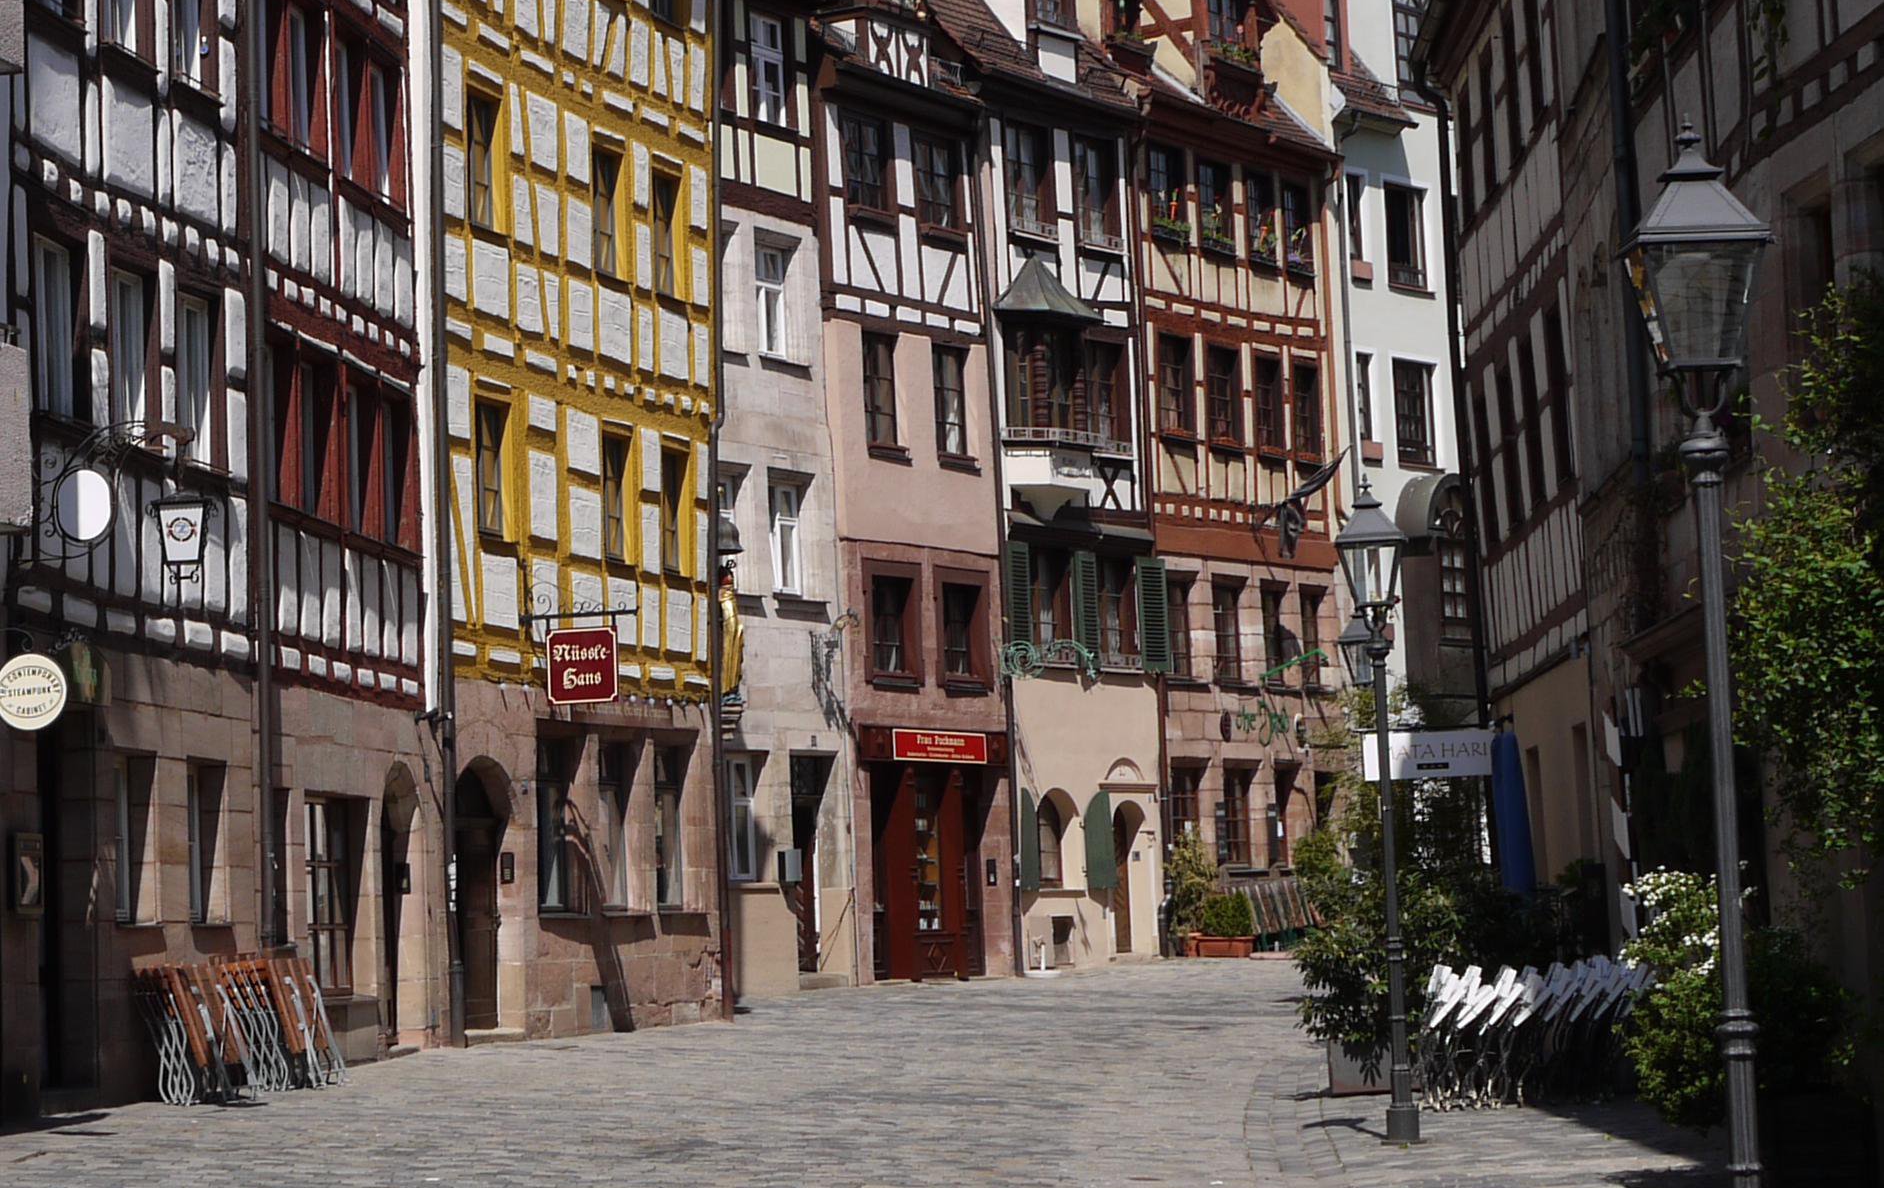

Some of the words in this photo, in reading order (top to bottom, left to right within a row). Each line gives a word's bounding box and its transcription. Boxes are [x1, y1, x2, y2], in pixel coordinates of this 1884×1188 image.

[552, 643, 611, 662] Nüssle-
[7, 667, 60, 693] CONTEMPORARY
[563, 667, 602, 690] Hans
[8, 685, 52, 697] STEAMPUNK
[16, 701, 47, 715] CABINET
[1440, 740, 1488, 758] HARI
